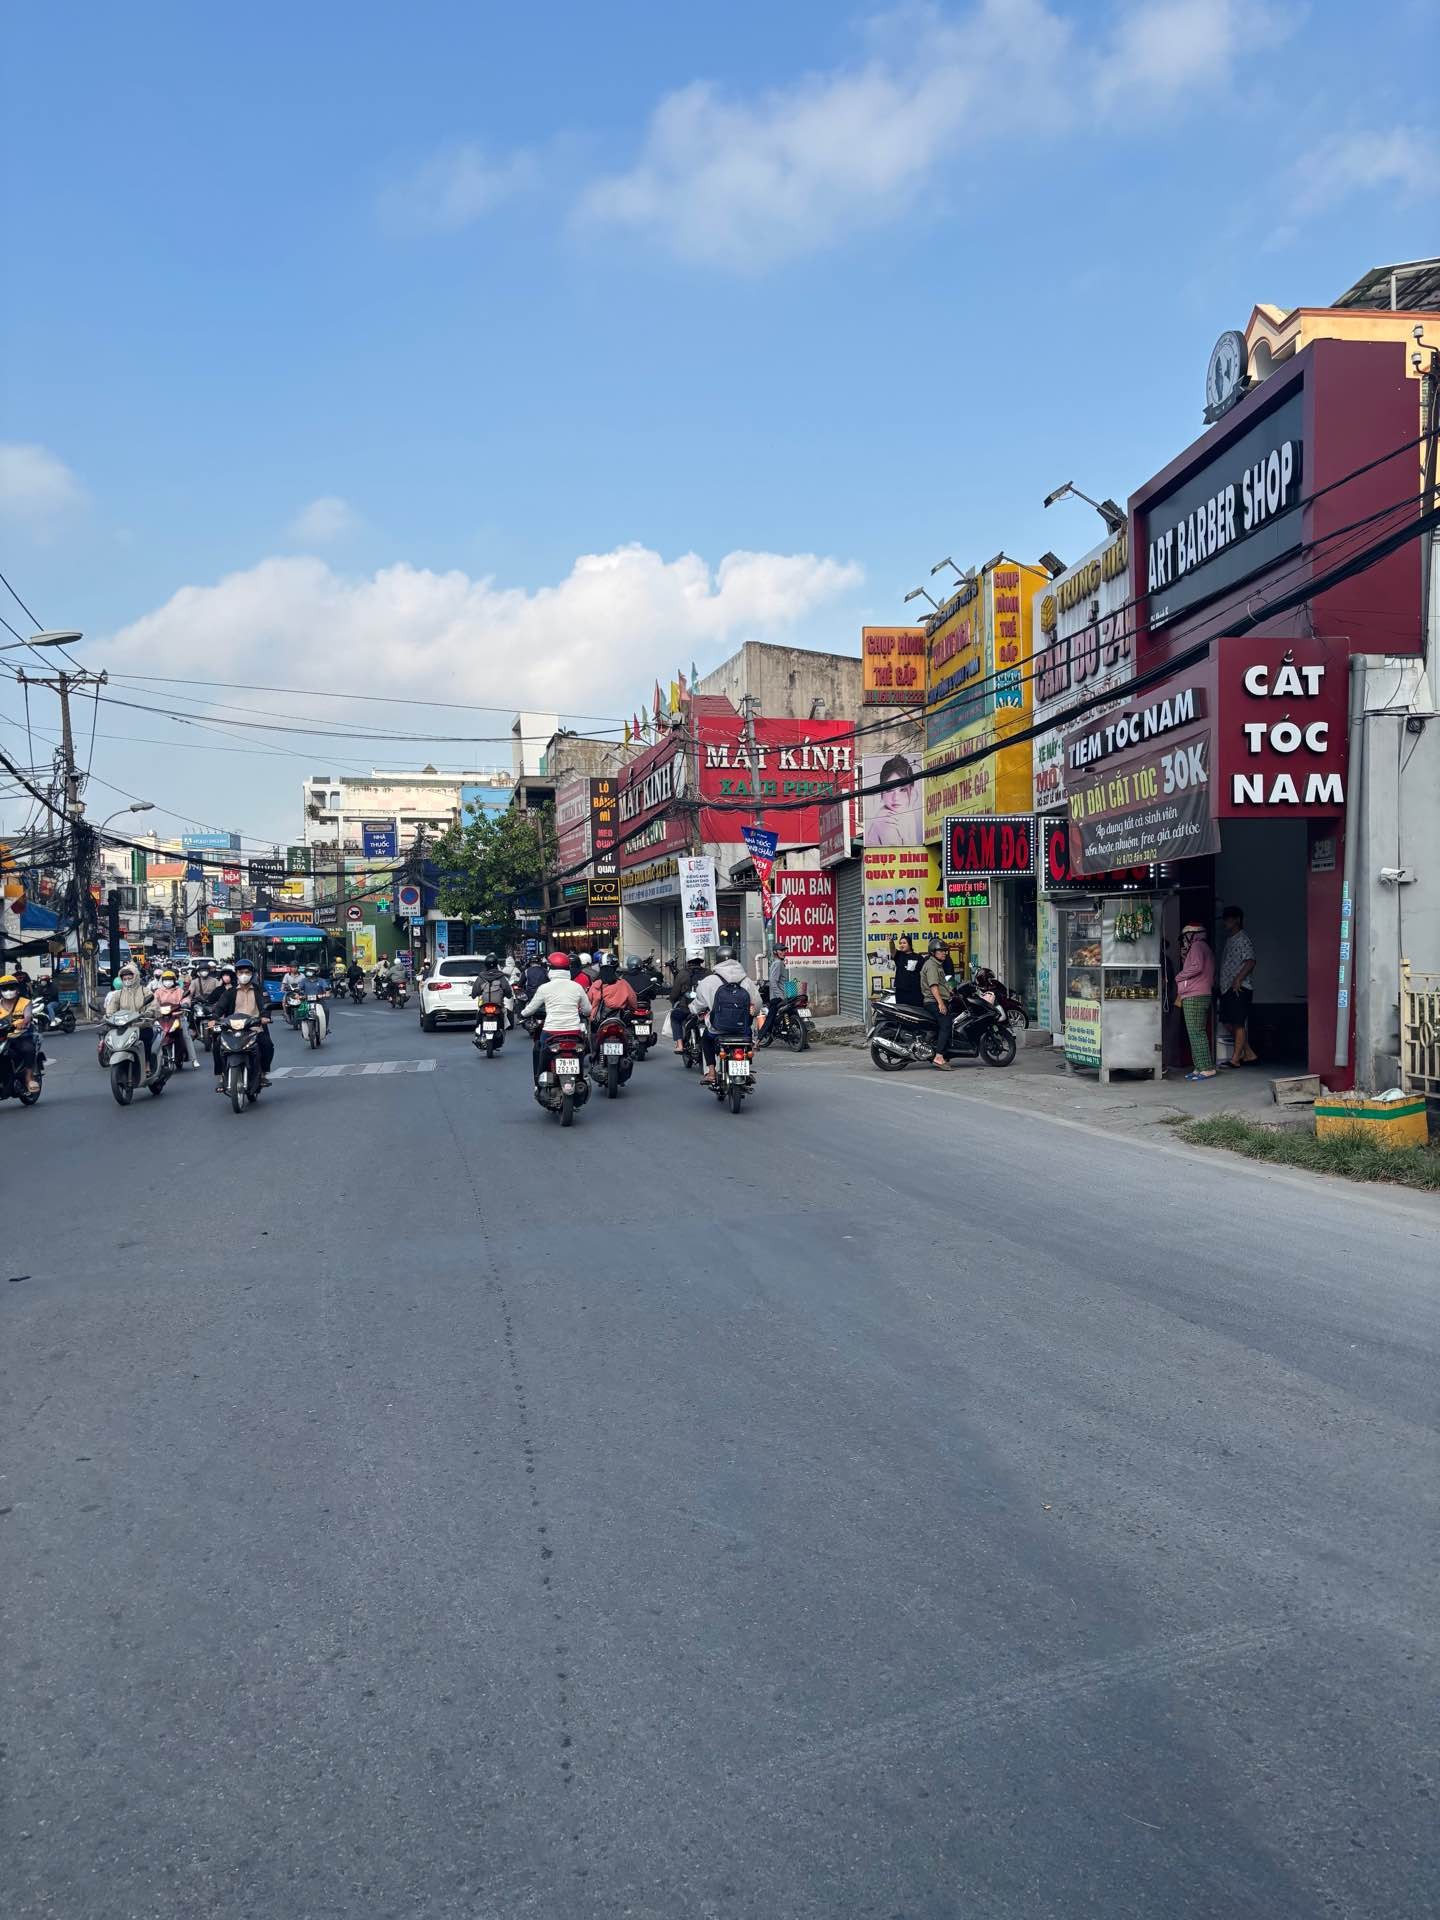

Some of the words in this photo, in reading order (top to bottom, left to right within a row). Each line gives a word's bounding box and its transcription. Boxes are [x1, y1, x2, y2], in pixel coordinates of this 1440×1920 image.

[1149, 528, 1173, 592] ART
[1177, 484, 1236, 576] BARBER
[1242, 441, 1293, 530] SHOP
[993, 572, 1019, 591] CHỤP
[1057, 560, 1101, 614] TRUNG
[996, 594, 1019, 613] HÌNH
[1000, 617, 1017, 638] THẺ
[866, 636, 895, 659] CHỤP
[898, 633, 925, 656] HÌNH
[874, 662, 893, 687] THẺ
[1244, 649, 1325, 696] CẮT
[1144, 688, 1195, 739] NAM
[1244, 713, 1329, 753] TÓC
[705, 728, 770, 769] MẮT
[778, 736, 851, 771] KÍNH
[599, 782, 609, 793] LÒ
[643, 762, 672, 811] KÍNH
[1109, 770, 1130, 809] CẮT
[1133, 764, 1158, 801] TÓC
[1160, 742, 1208, 795] 30K
[1233, 773, 1345, 804] NAM
[593, 796, 616, 808] BÁNH
[600, 811, 610, 822] MÌ
[1106, 821, 1123, 835] dụng
[1124, 815, 1134, 830] tất
[1135, 816, 1144, 828] cả
[1145, 810, 1161, 825] sinh
[1162, 806, 1178, 822] viên
[952, 824, 996, 870] CẦM
[1001, 824, 1029, 870] ĐỒ
[1115, 836, 1139, 852] nhuộm
[1141, 832, 1155, 849] free
[1157, 827, 1171, 845] giá
[597, 864, 616, 875] QUAY
[864, 854, 896, 867] CHỤP
[899, 851, 929, 863] HÌNH
[781, 878, 806, 896] MUA
[809, 874, 832, 895] BÁN
[865, 870, 896, 880] QUAY
[899, 869, 929, 879] PHIM
[282, 914, 312, 923] JOTUN
[779, 901, 801, 926] SỬA
[804, 903, 834, 926] CHỮA
[928, 909, 942, 924] THẺ
[822, 935, 835, 953] PC
